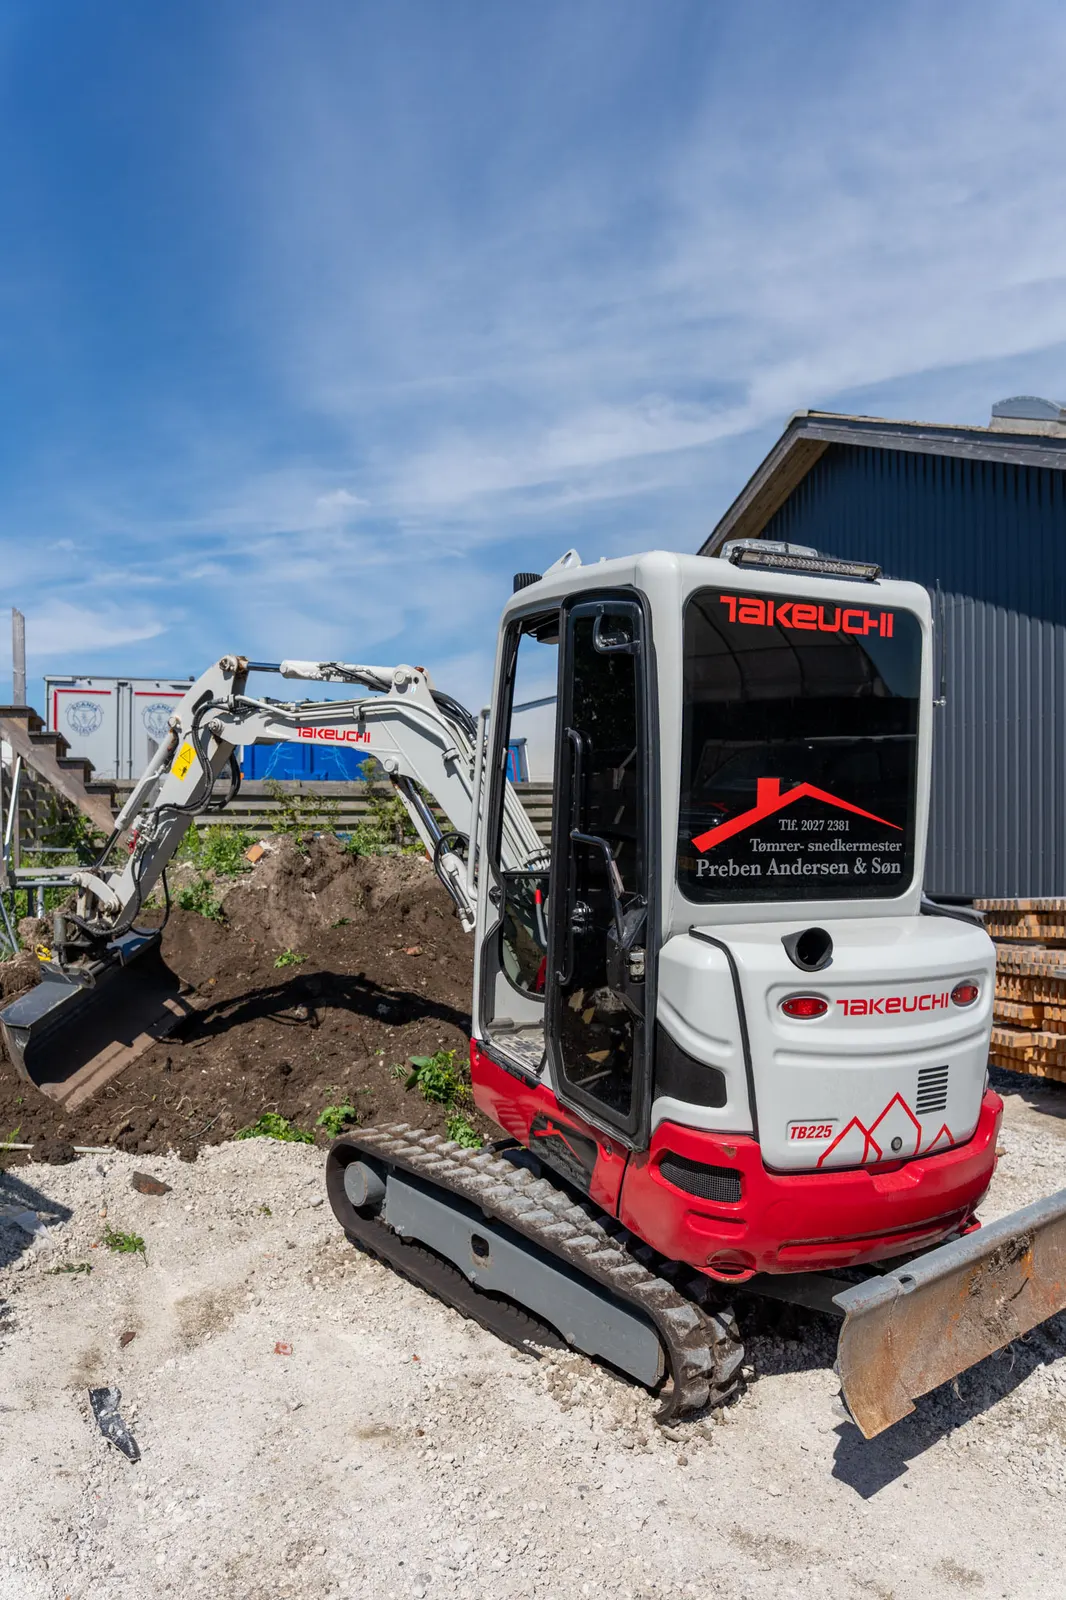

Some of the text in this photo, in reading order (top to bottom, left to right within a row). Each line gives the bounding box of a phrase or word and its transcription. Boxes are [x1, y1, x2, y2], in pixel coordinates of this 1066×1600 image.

[719, 595, 894, 638] TAKEUCHI
[71, 701, 98, 712] SCANIA
[295, 726, 371, 743] TAKEUCHI
[778, 819, 850, 831] Tlf. 2027 2381
[749, 838, 902, 852] Tømrer- snedkermester
[695, 856, 902, 877] Preben Andersen & Søn
[836, 992, 949, 1016] TAKEUCHI
[790, 1125, 833, 1139] TB225
